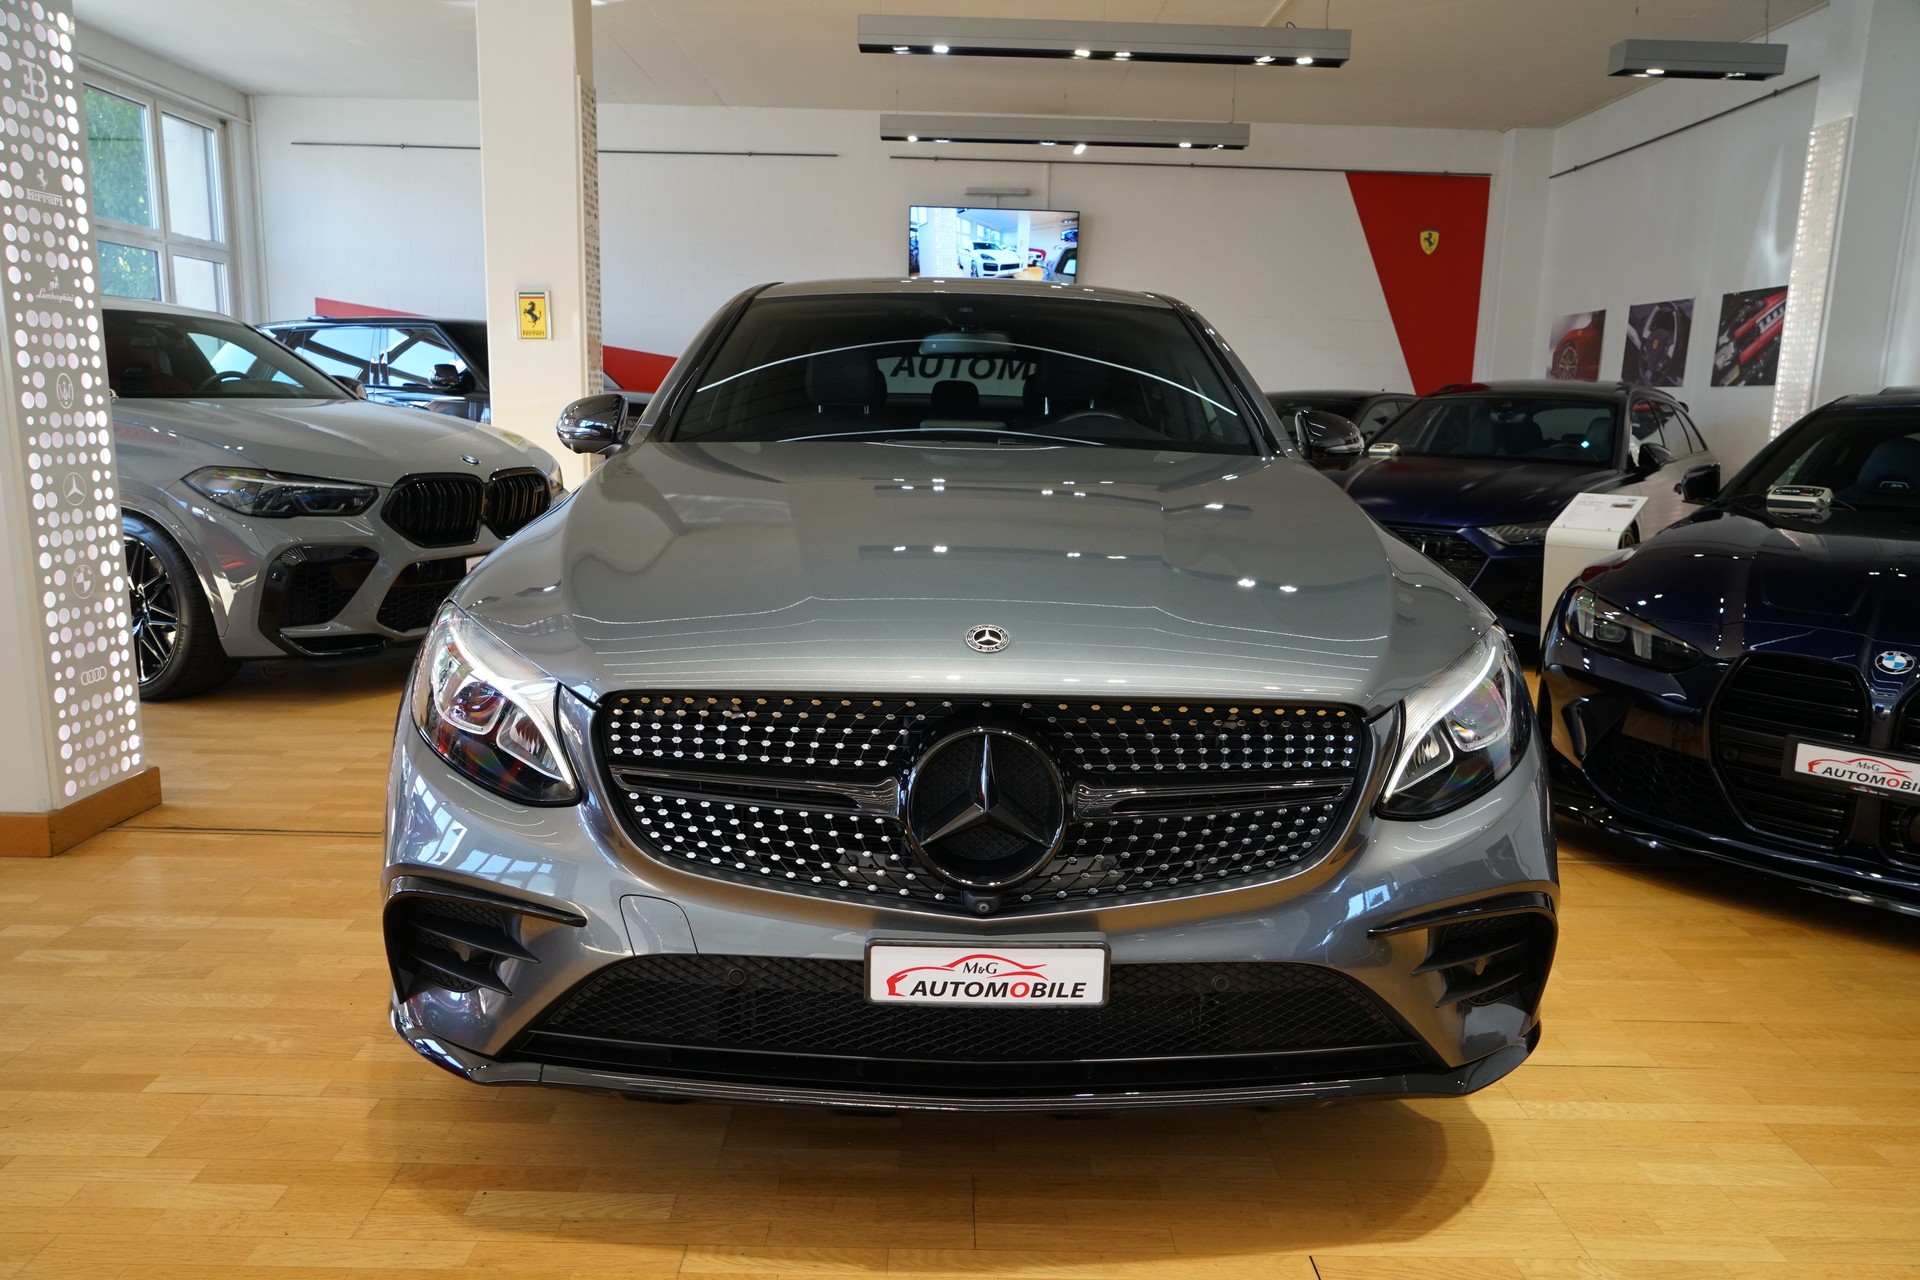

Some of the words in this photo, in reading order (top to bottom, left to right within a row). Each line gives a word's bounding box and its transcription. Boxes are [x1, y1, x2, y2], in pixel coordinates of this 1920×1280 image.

[26, 188, 63, 207] Ferrari
[36, 288, 74, 303] Lamborghini
[1856, 761, 1881, 772] M&G
[962, 962, 998, 975] M&G
[910, 980, 1087, 998] AUTOMOBILE
